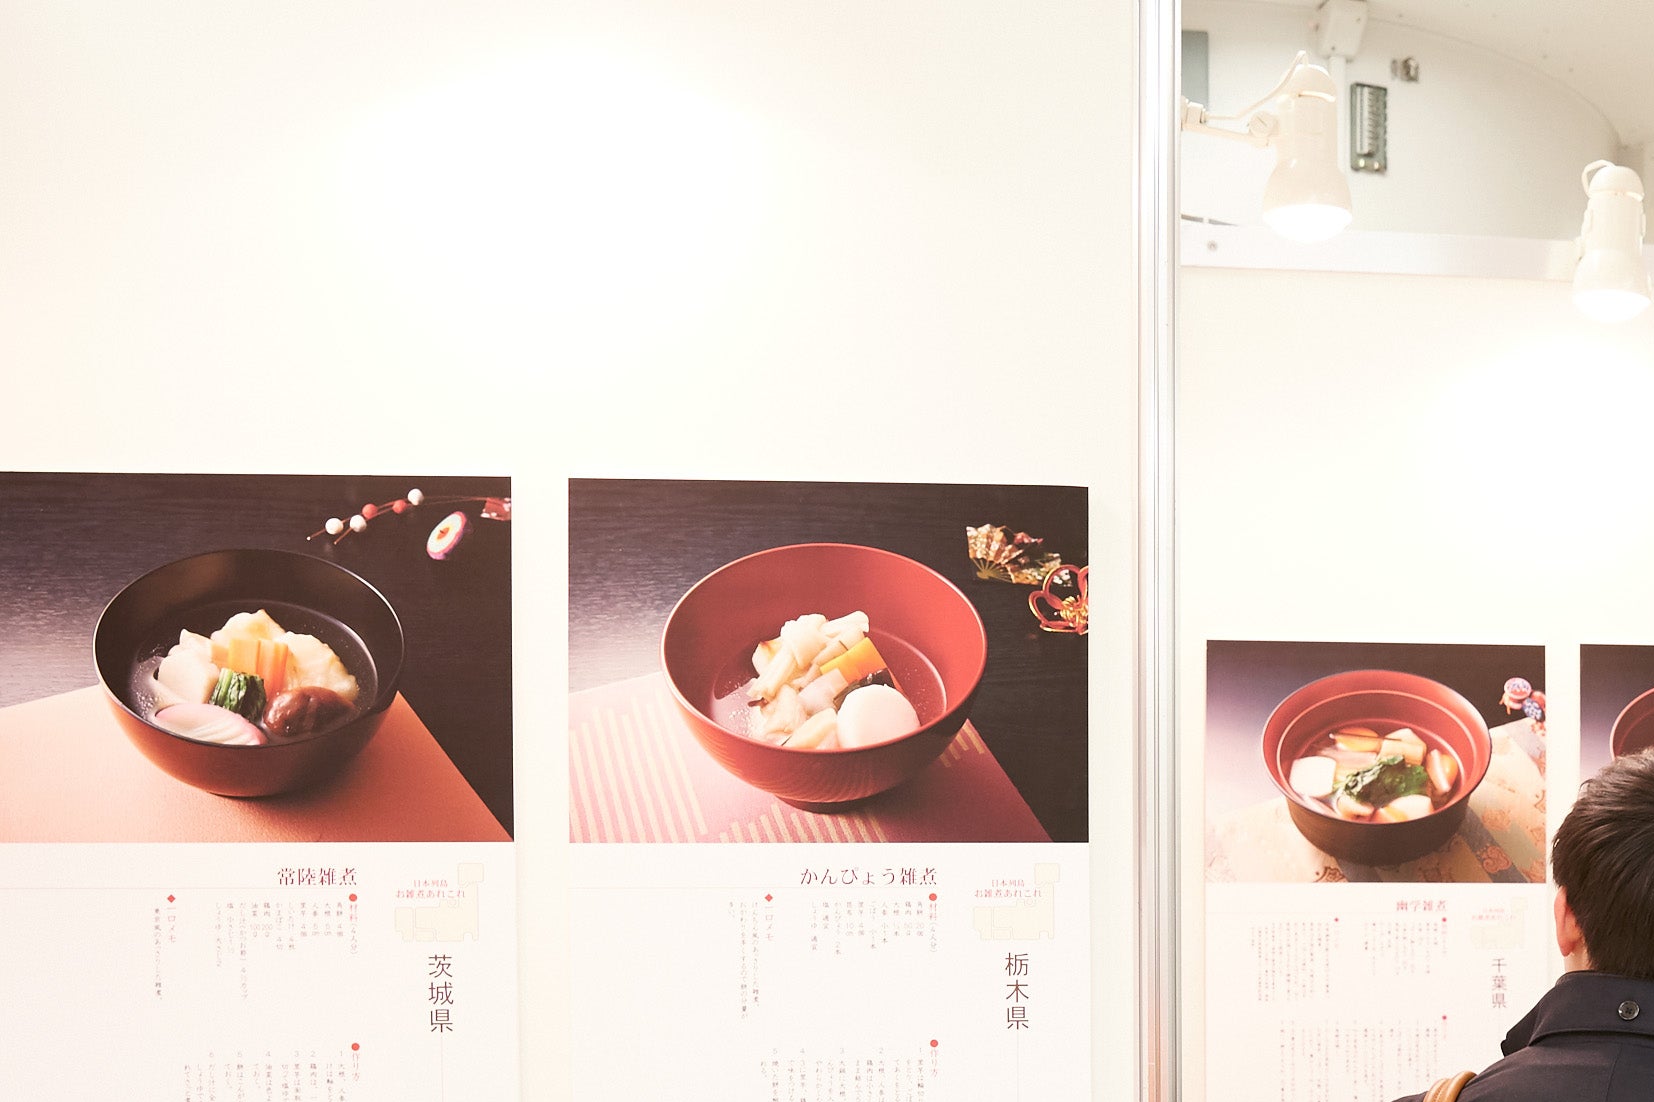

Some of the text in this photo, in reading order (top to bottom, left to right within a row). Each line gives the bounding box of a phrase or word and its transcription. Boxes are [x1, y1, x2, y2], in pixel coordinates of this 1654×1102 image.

[277, 867, 358, 887] 常陸雑煮
[413, 879, 449, 888] 日本列島
[800, 868, 937, 886] かんぴょう雑煮
[991, 879, 1025, 887] 日本列島
[395, 889, 466, 899] お雑煮あれこれ
[974, 889, 1041, 898] お雑煮あれこれ
[1005, 952, 1029, 1030] 栃木県
[1491, 958, 1508, 1009] 千葉県
[428, 954, 454, 1033] 茨城県
